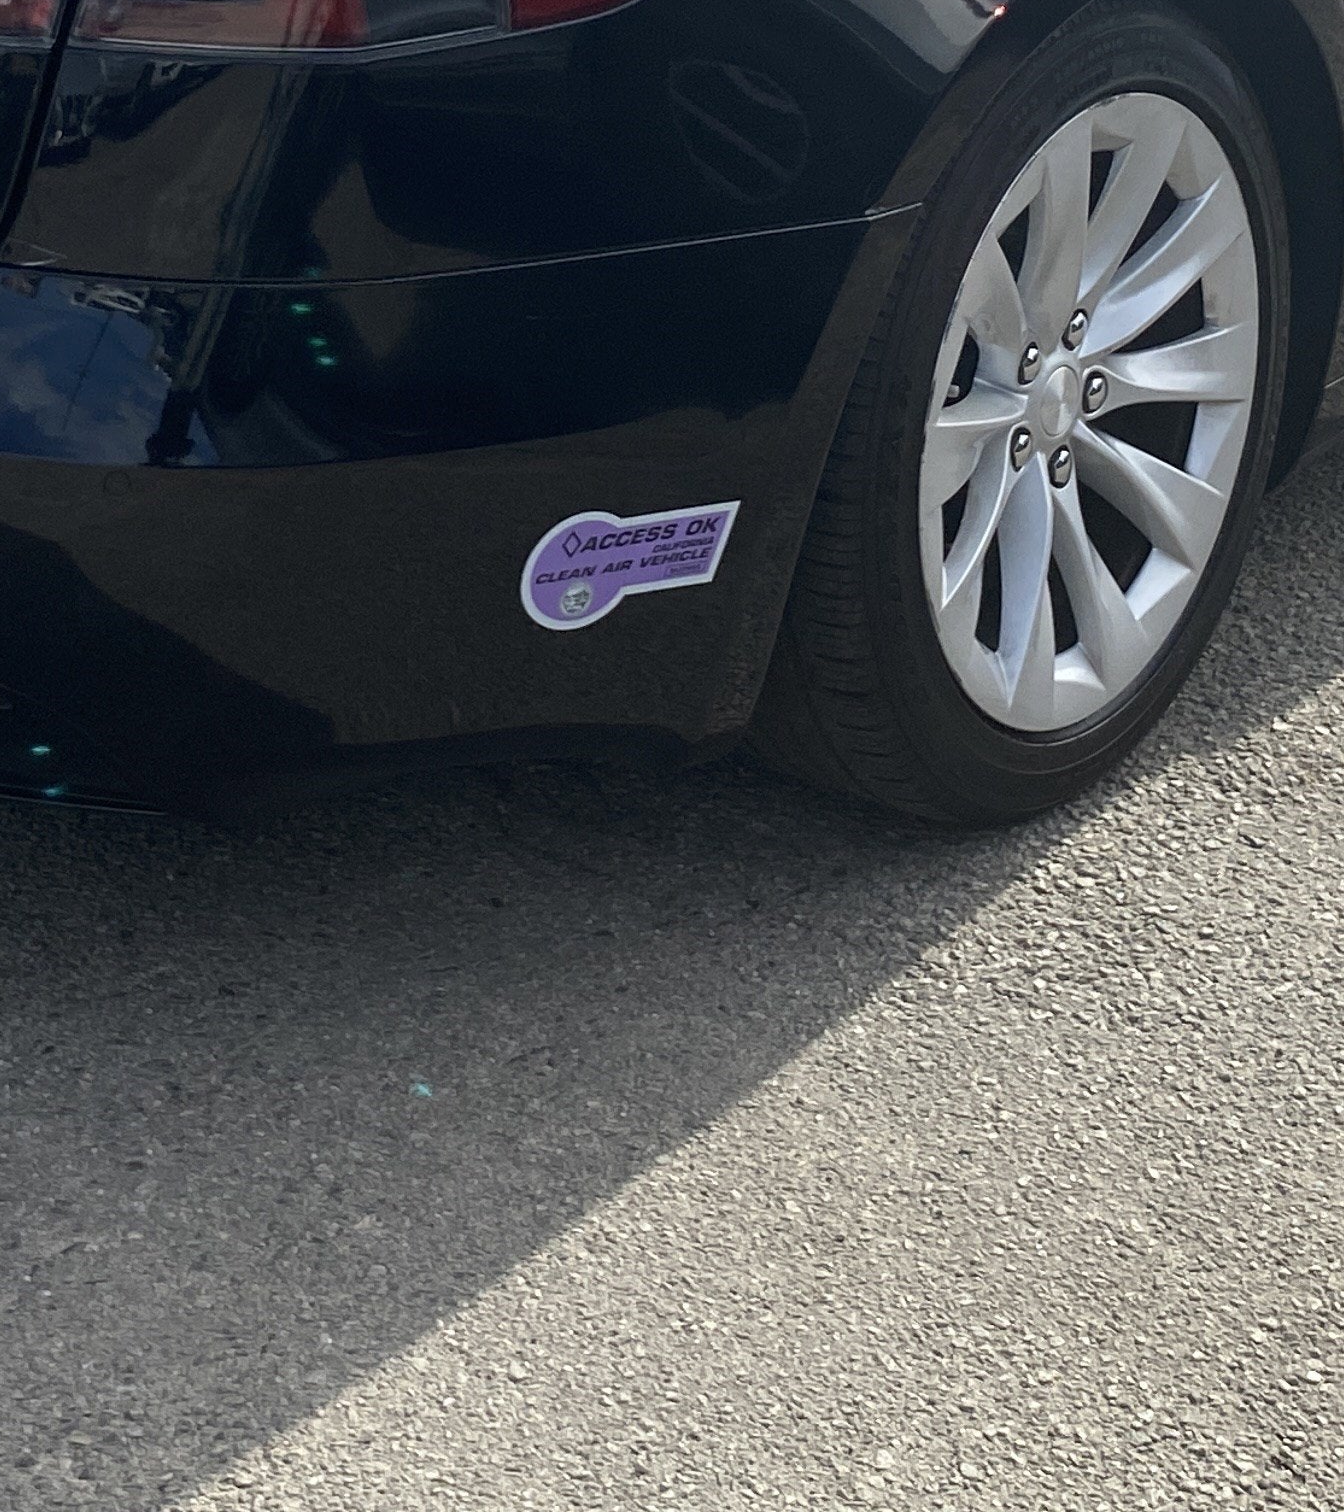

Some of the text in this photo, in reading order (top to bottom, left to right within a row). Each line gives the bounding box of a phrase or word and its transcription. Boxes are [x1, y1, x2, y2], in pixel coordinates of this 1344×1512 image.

[580, 516, 721, 554] ACCESS OK
[535, 547, 710, 585] CLEAN AIR VEHICLE
